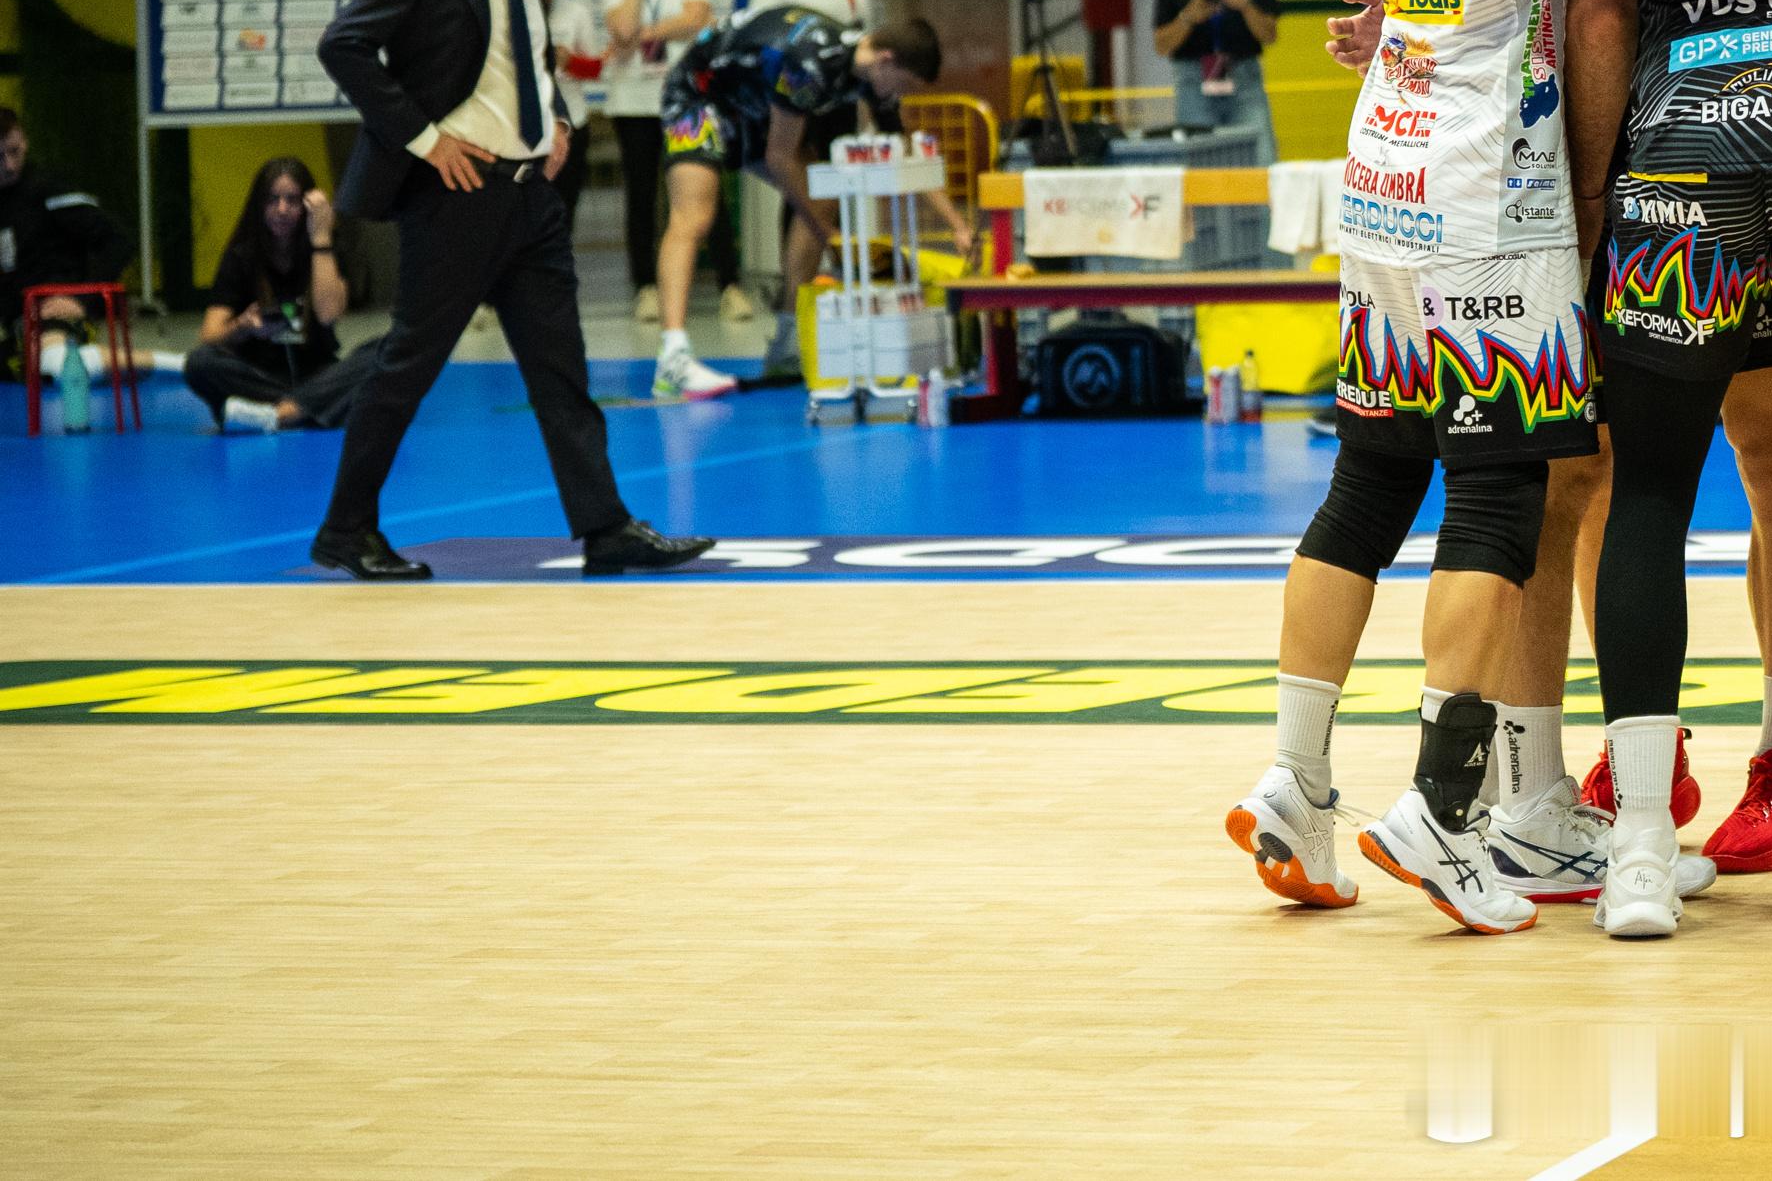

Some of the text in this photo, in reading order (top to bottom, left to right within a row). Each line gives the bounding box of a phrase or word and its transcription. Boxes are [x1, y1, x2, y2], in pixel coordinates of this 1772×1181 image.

[1388, 139, 1430, 149] METALLICHE
[1519, 151, 1556, 162] MAB
[1380, 166, 1426, 204] UMBRA
[1341, 194, 1444, 243] ERDUCCI
[1360, 229, 1392, 244] ELETTRICI
[1394, 236, 1440, 253] INDUSTRIALI
[1444, 294, 1526, 321] T&RB
[1648, 331, 1684, 345] SPORT NUTRITION
[1337, 378, 1392, 408] RREDUE
[1447, 423, 1493, 434] adrenalina
[1508, 737, 1523, 794] adrenalina
